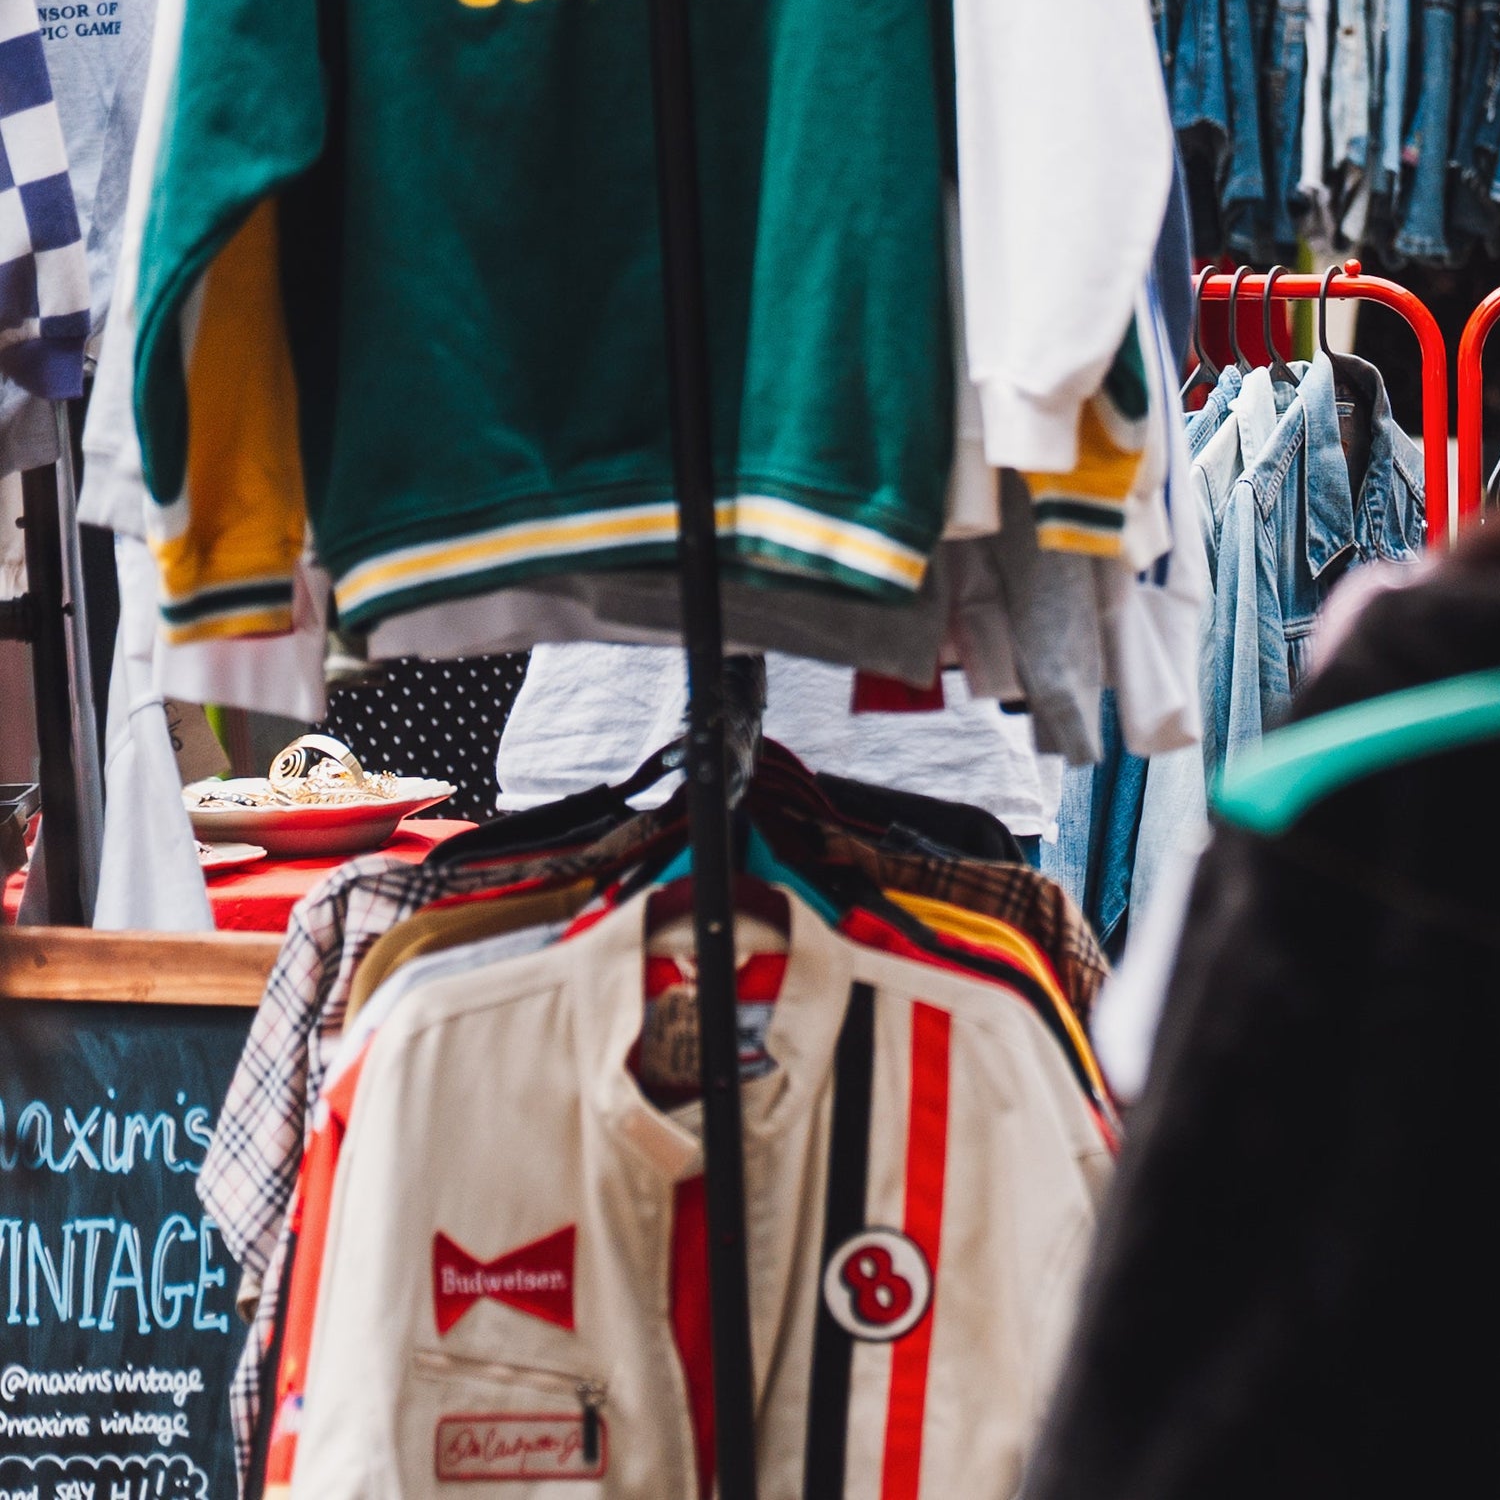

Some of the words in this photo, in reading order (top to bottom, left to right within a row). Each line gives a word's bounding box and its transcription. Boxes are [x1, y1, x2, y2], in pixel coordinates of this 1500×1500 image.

[37, 3, 90, 21] NSOR
[96, 1, 119, 16] OF
[0, 1087, 214, 1174] axim's
[840, 1242, 914, 1327] 8
[0, 1409, 91, 1438] maxims
